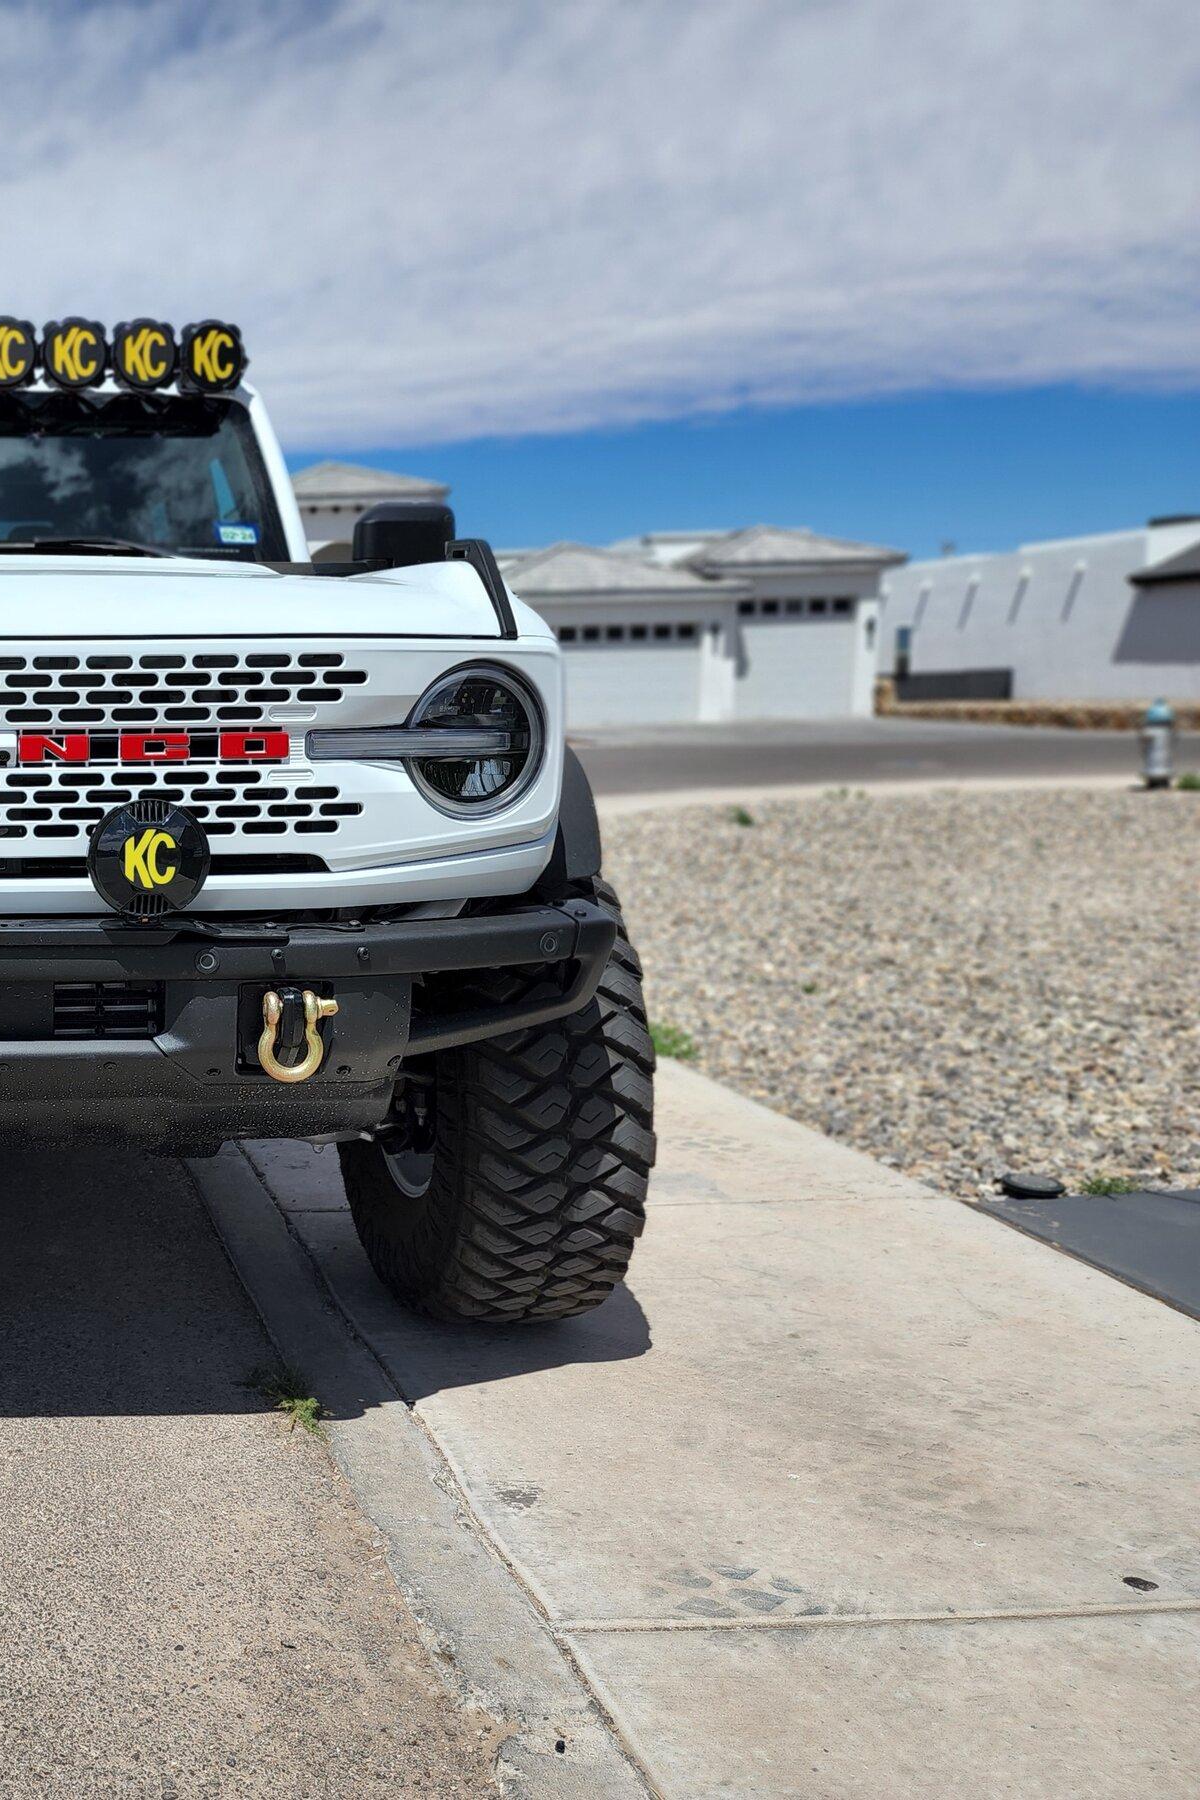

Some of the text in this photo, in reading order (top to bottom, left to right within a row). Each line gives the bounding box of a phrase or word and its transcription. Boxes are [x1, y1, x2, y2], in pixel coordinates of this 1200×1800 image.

[53, 326, 97, 381] KC
[124, 327, 167, 382] KC
[193, 329, 234, 383] KC
[124, 828, 176, 889] KC
